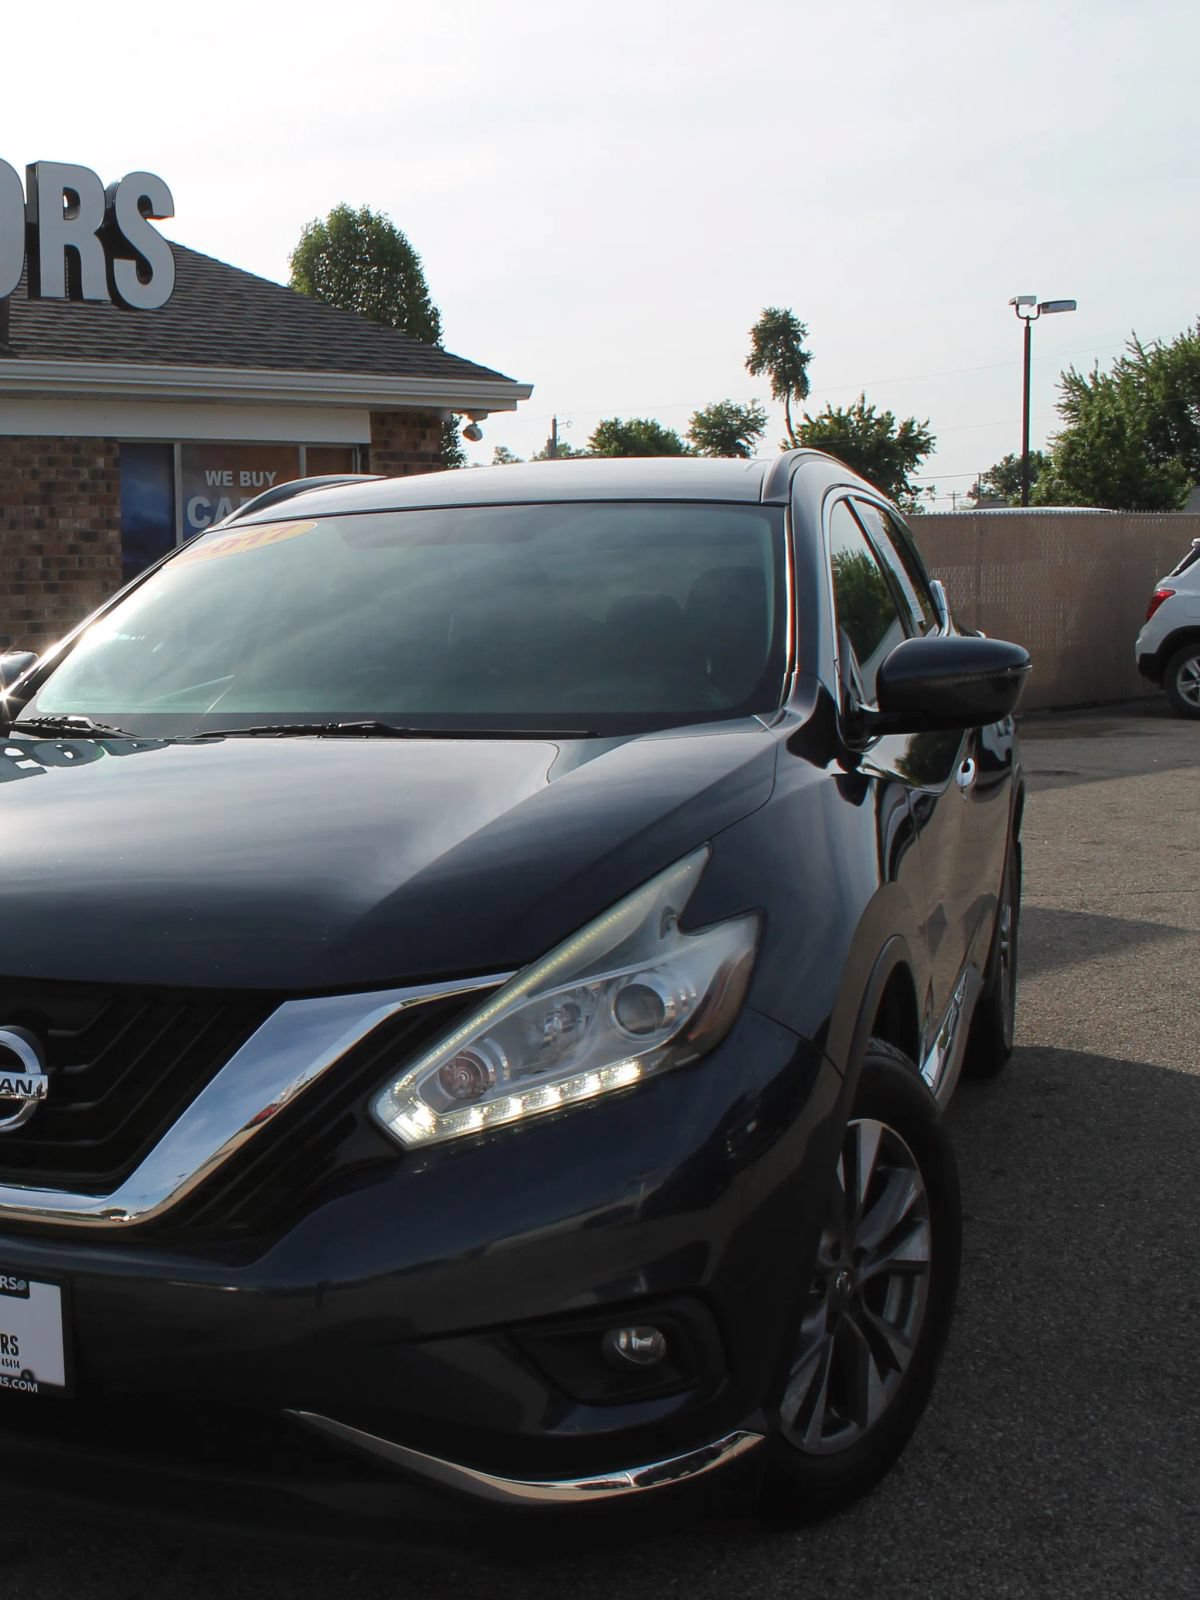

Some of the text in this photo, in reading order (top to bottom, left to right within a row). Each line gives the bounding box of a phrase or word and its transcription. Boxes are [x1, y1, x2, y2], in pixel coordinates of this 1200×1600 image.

[205, 471, 276, 487] WE BUY
[1, 1358, 20, 1369] 45414
